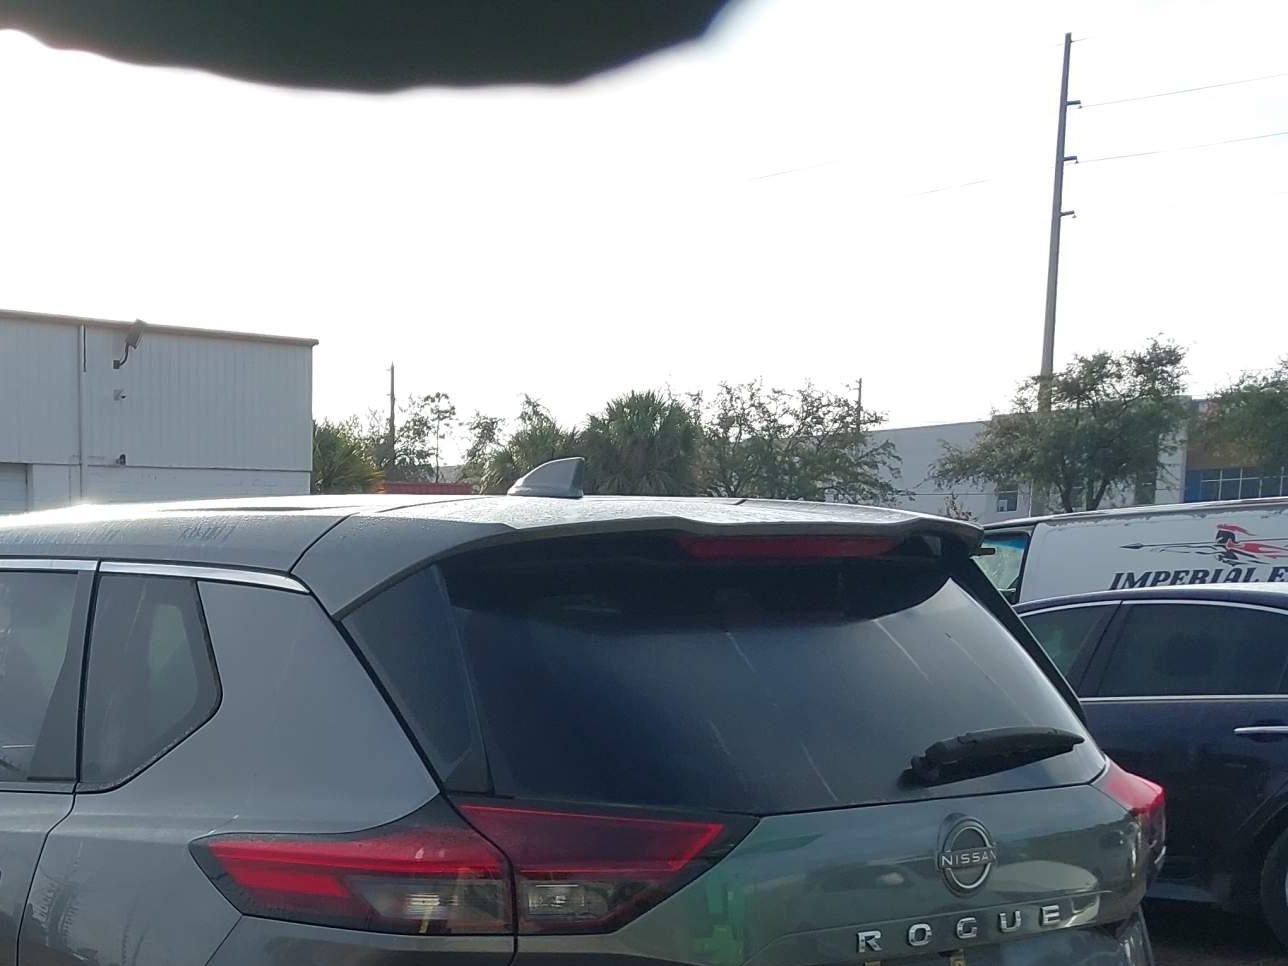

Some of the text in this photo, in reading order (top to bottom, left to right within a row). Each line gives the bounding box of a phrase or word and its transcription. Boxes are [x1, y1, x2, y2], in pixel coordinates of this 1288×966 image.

[1109, 567, 1259, 590] IMPERIAL
[941, 850, 996, 866] NISSAN
[856, 904, 1060, 953] ROGUE
